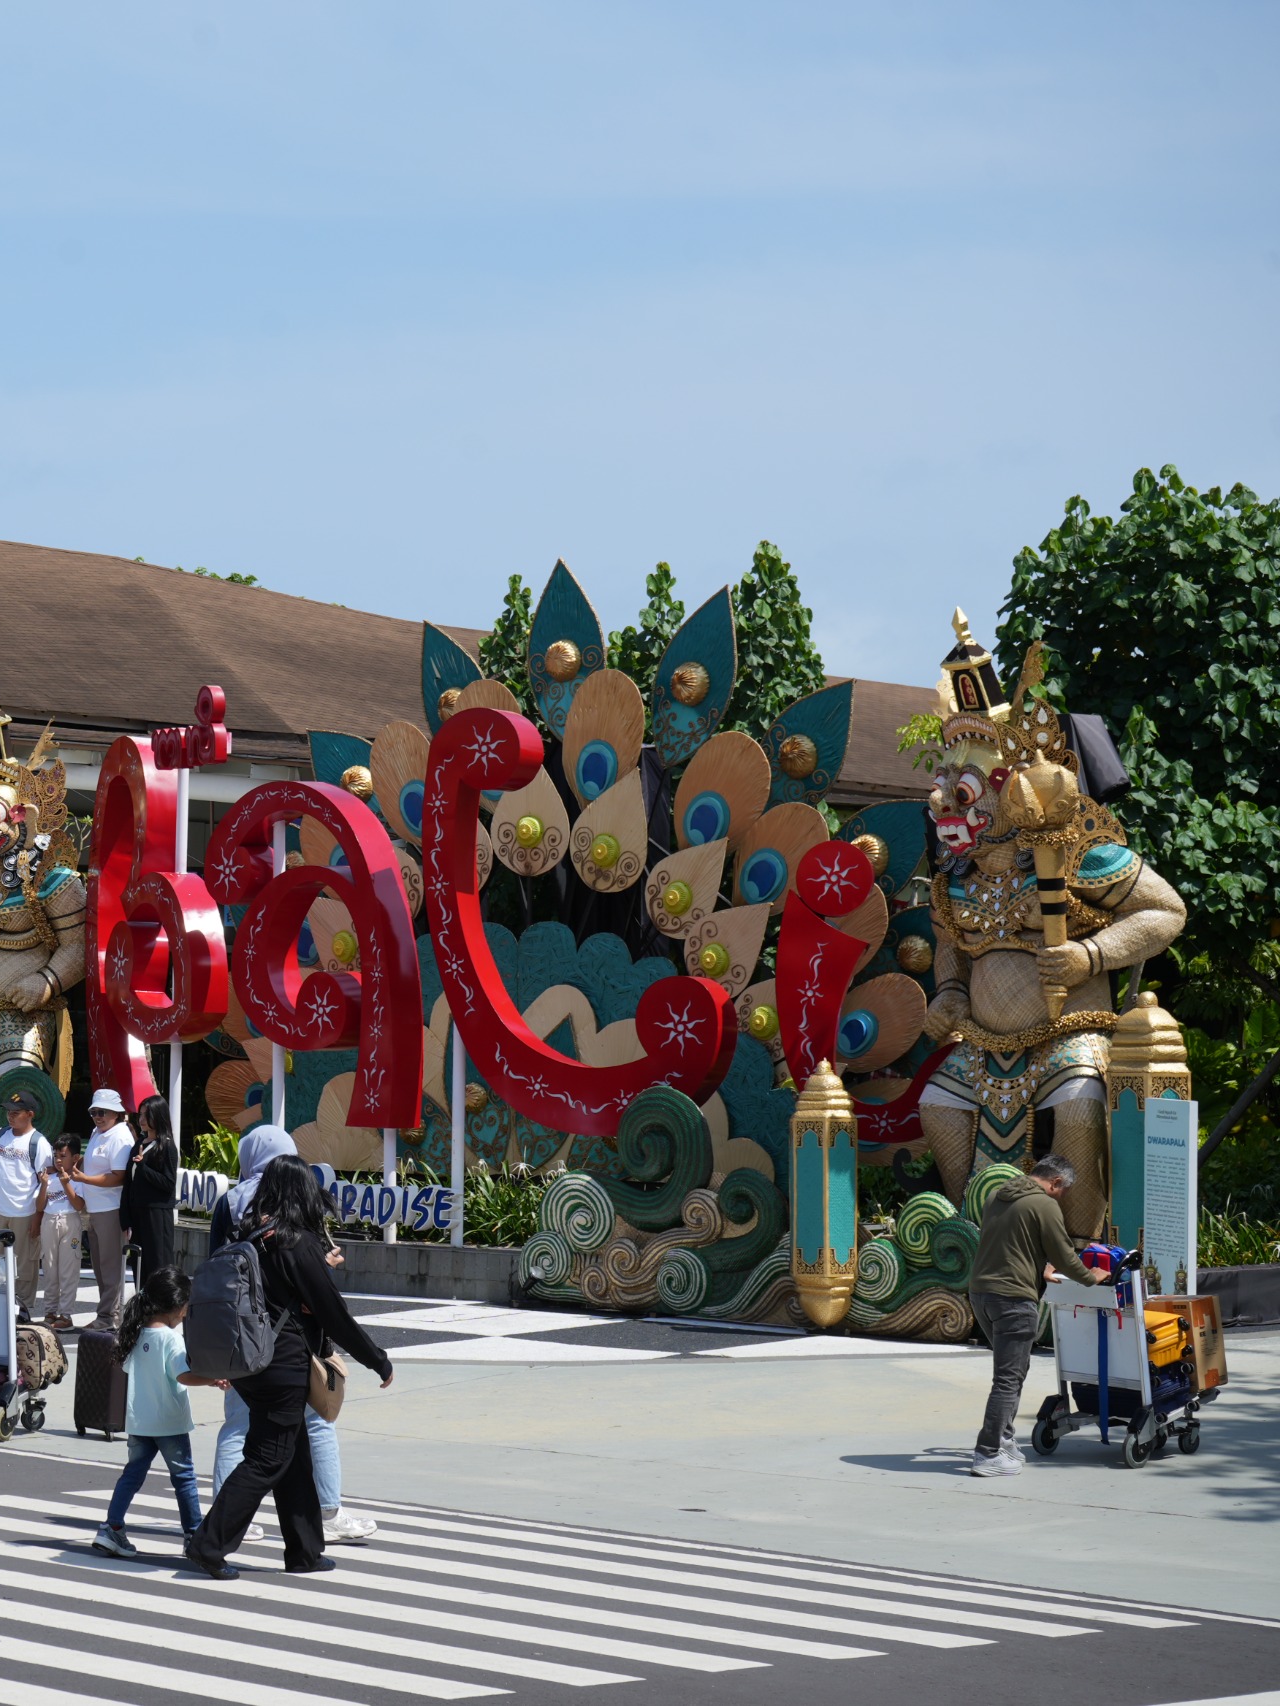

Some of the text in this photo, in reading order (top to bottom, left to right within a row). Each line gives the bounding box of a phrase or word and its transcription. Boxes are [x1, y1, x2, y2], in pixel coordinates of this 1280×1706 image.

[1147, 1135, 1186, 1148] DWARAPALA
[176, 1163, 456, 1231] AND ARADISE
